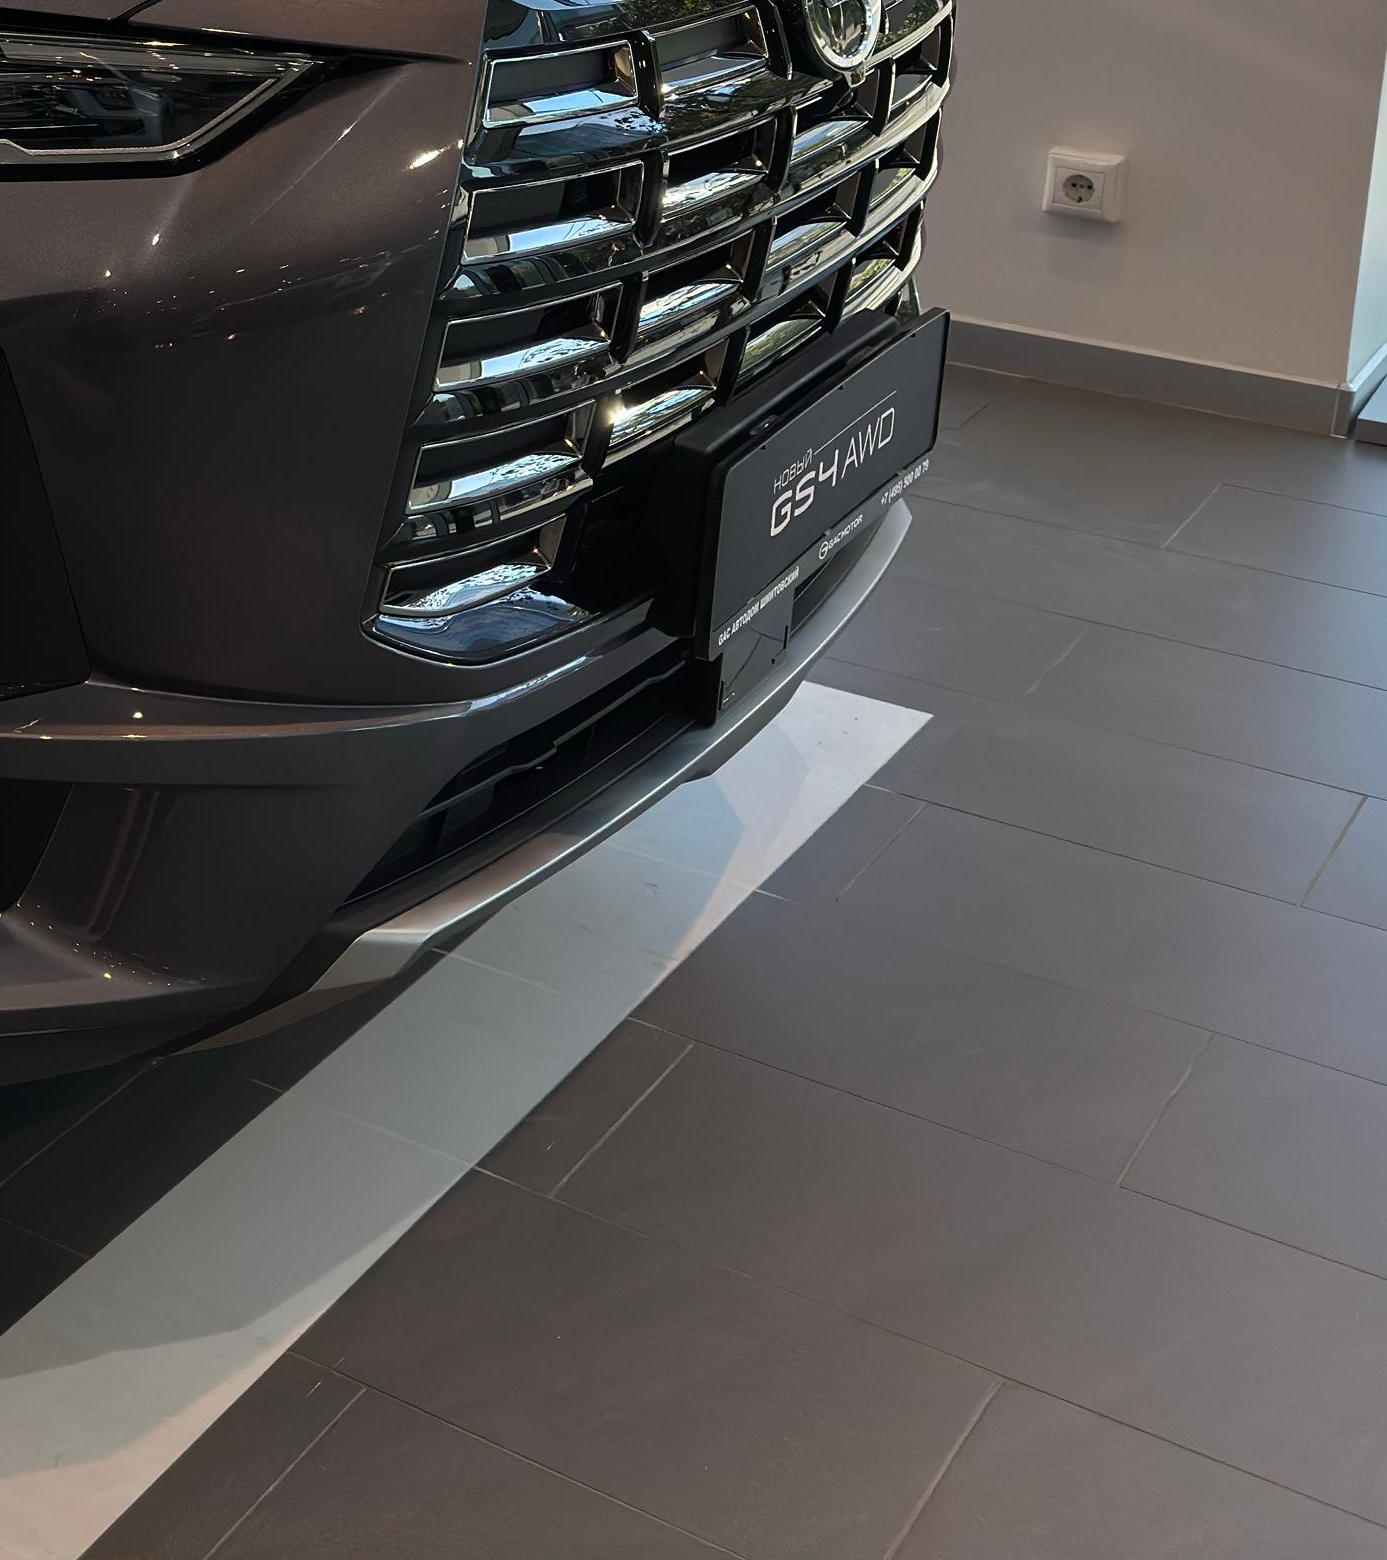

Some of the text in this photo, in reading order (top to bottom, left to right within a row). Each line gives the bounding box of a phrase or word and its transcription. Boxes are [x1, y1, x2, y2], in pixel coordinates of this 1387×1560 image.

[770, 407, 895, 536] GS4 AWD
[773, 448, 813, 495] НОВЫЙ
[718, 626, 731, 646] GAC
[731, 601, 760, 635] АВТОДОМ
